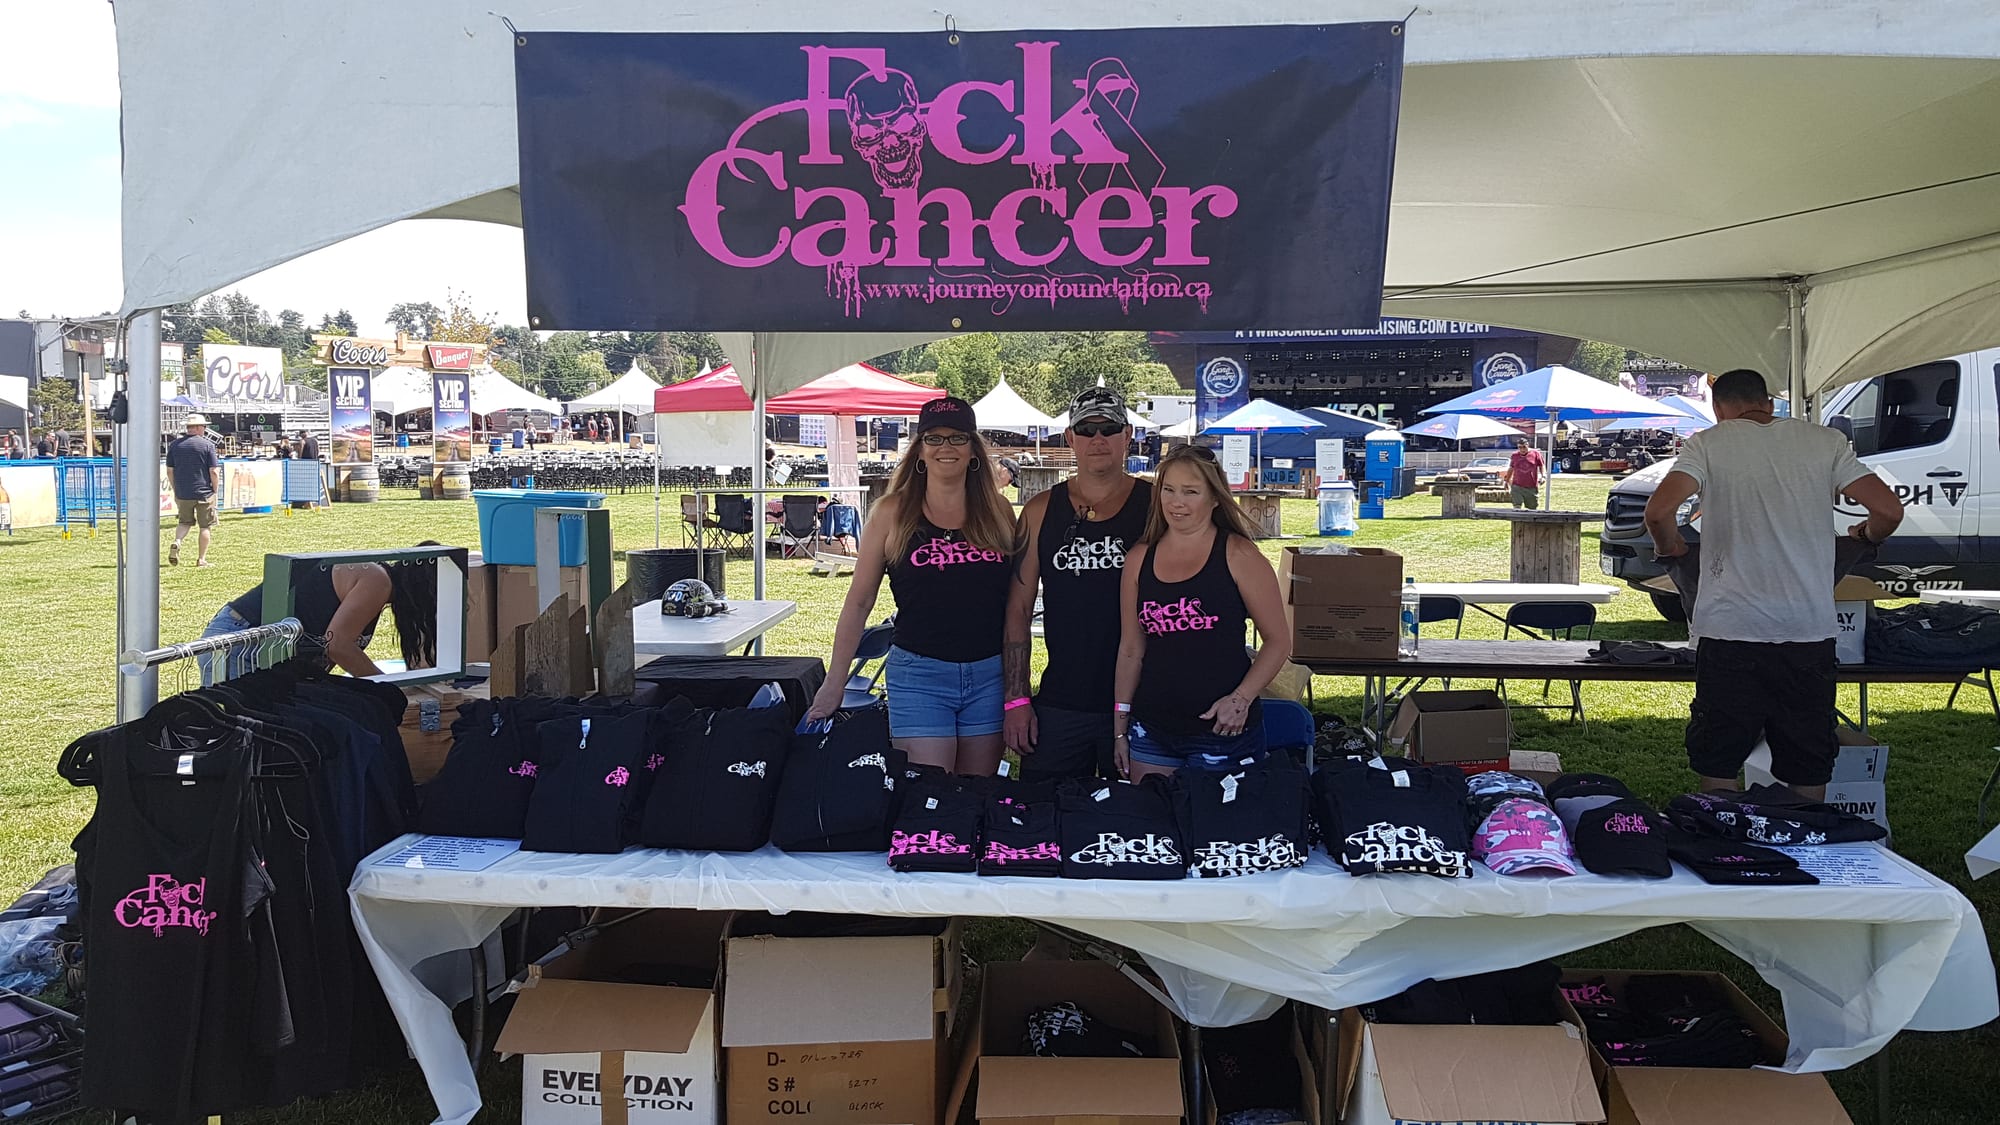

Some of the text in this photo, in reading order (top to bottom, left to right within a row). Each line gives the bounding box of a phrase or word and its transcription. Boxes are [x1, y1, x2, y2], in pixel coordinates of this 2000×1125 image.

[677, 147, 1239, 270] Cancer
[864, 274, 1213, 316] www.journeyonfoundation.ca
[333, 338, 388, 365] Coors
[435, 349, 469, 366] Banquet
[205, 356, 285, 399] Coors
[335, 375, 364, 397] VIP
[438, 379, 465, 400] VIP
[335, 397, 364, 406] SECTION
[439, 400, 464, 409] SECTION
[1263, 470, 1296, 482] NUDE
[1053, 550, 1125, 571] Cance
[1875, 581, 1963, 593] OTO GUZZI
[1604, 817, 1650, 835] Cancer
[542, 1069, 693, 1097] EVEDAY
[767, 1077, 779, 1092] S
[542, 1092, 693, 1111] COLLCTION
